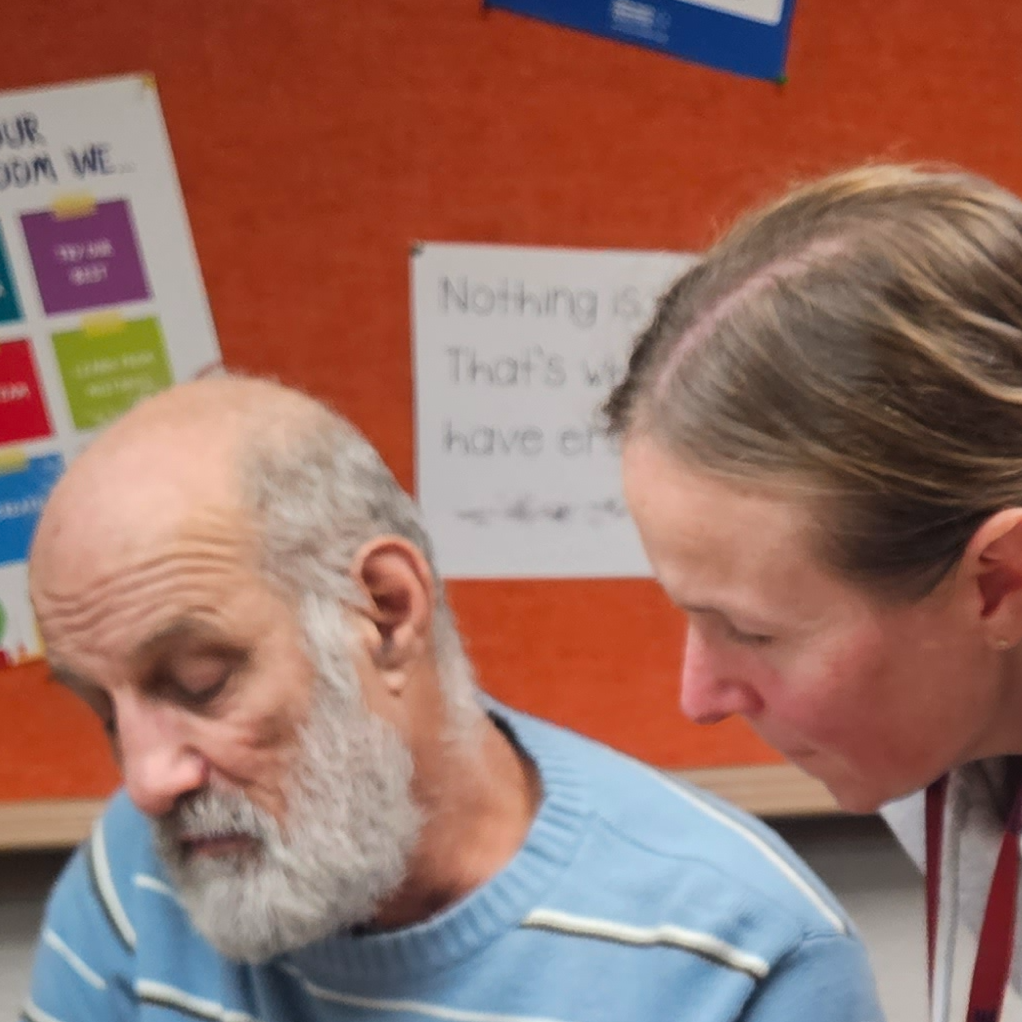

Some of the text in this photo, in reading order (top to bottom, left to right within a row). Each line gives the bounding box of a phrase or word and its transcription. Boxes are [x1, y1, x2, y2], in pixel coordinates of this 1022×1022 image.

[0, 112, 46, 149] UR
[439, 275, 641, 329] Nothing is
[445, 345, 566, 387] That's
[443, 420, 545, 456] have
